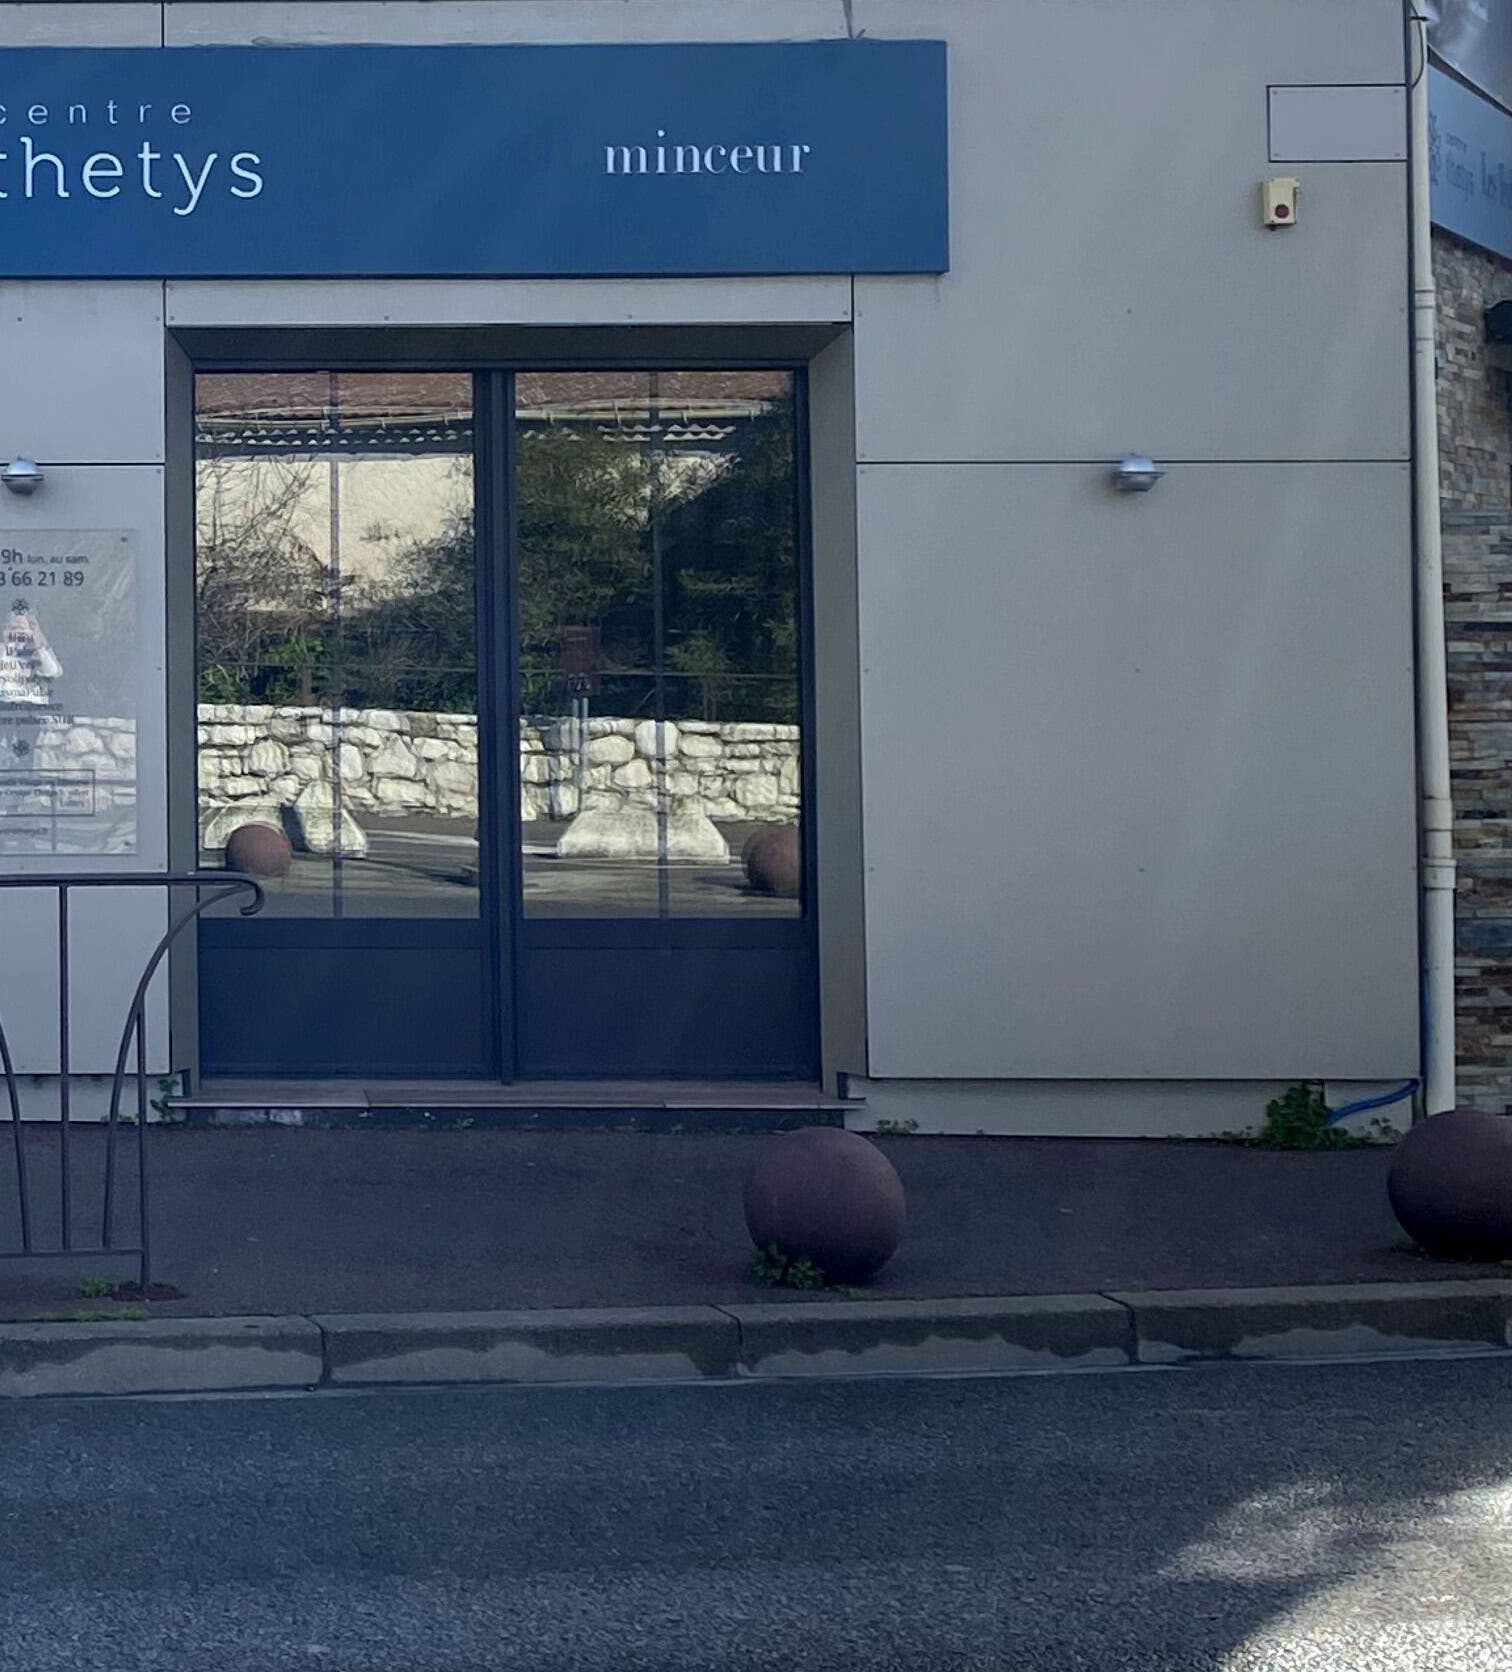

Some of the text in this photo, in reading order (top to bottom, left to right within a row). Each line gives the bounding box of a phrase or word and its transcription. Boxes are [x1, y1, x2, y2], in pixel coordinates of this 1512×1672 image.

[602, 129, 812, 175] minceur
[49, 556, 63, 564] au
[11, 571, 33, 587] 66
[37, 571, 56, 587] 21
[63, 571, 85, 587] 89
